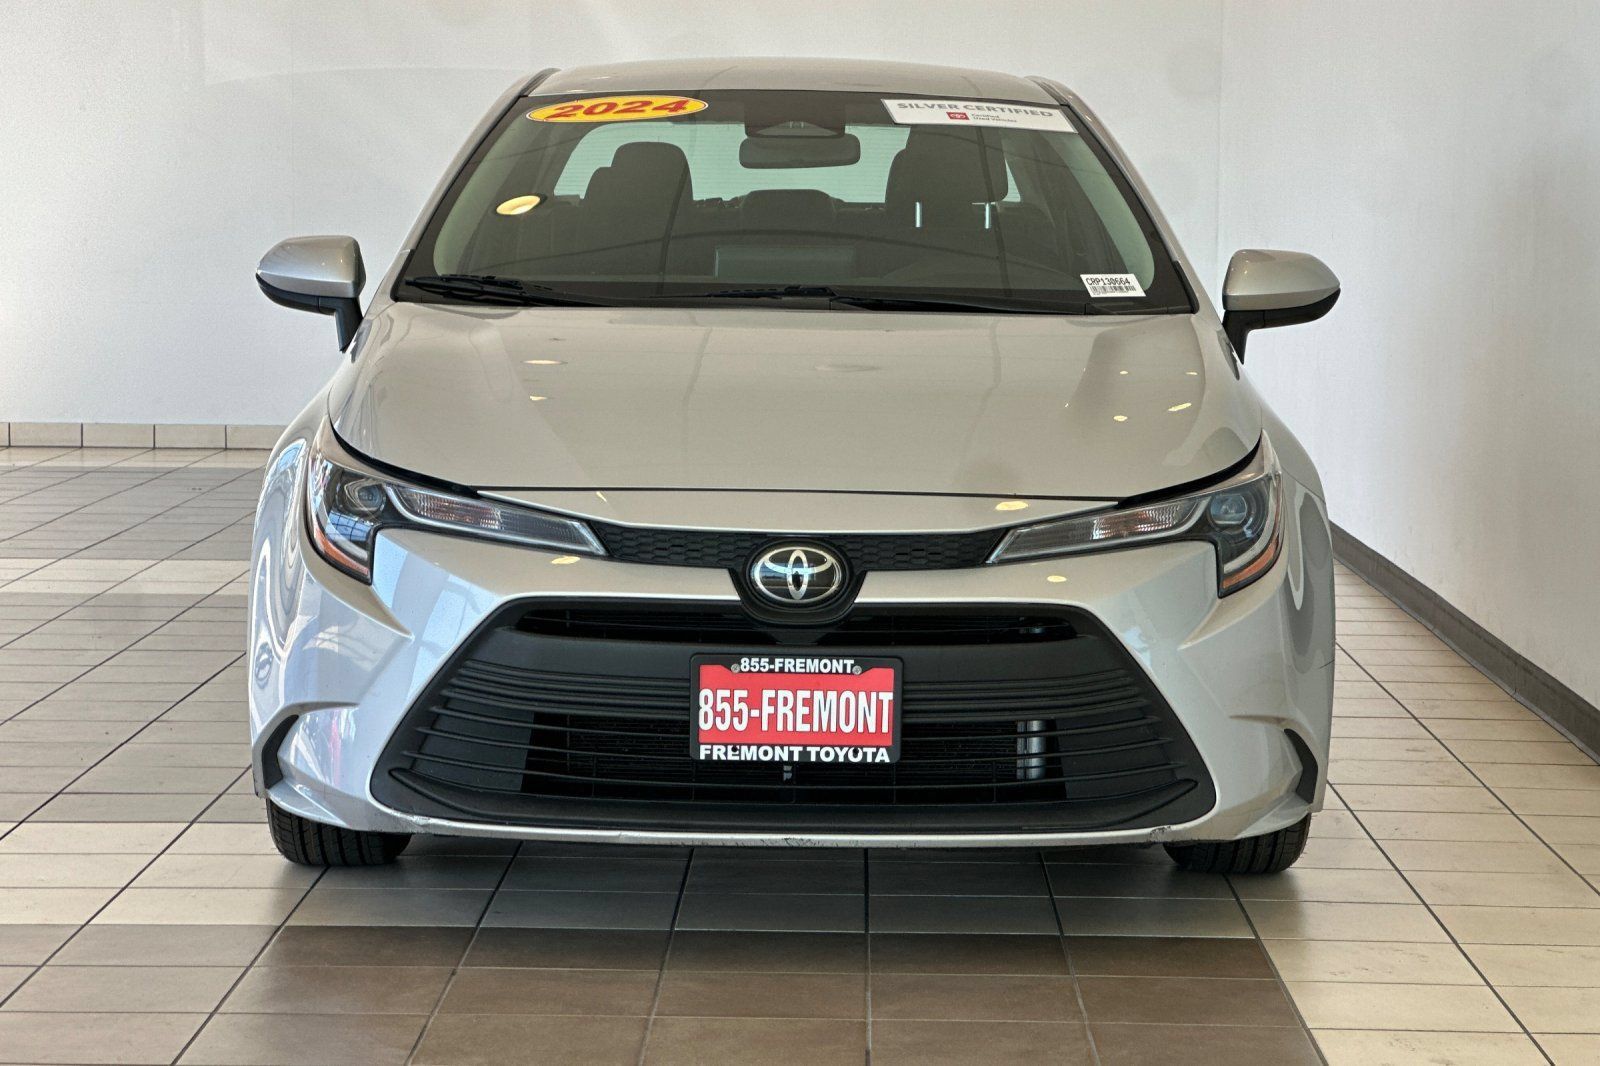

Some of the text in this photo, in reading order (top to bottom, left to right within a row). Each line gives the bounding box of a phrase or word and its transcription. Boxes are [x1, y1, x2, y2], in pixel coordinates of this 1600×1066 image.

[544, 100, 689, 119] 2024
[897, 102, 1053, 117] SILVER CERTIFIED
[740, 657, 855, 674] 855-FREMONT
[699, 688, 894, 734] 855-FREMONT
[699, 744, 891, 763] FREMONT TOYOTA
